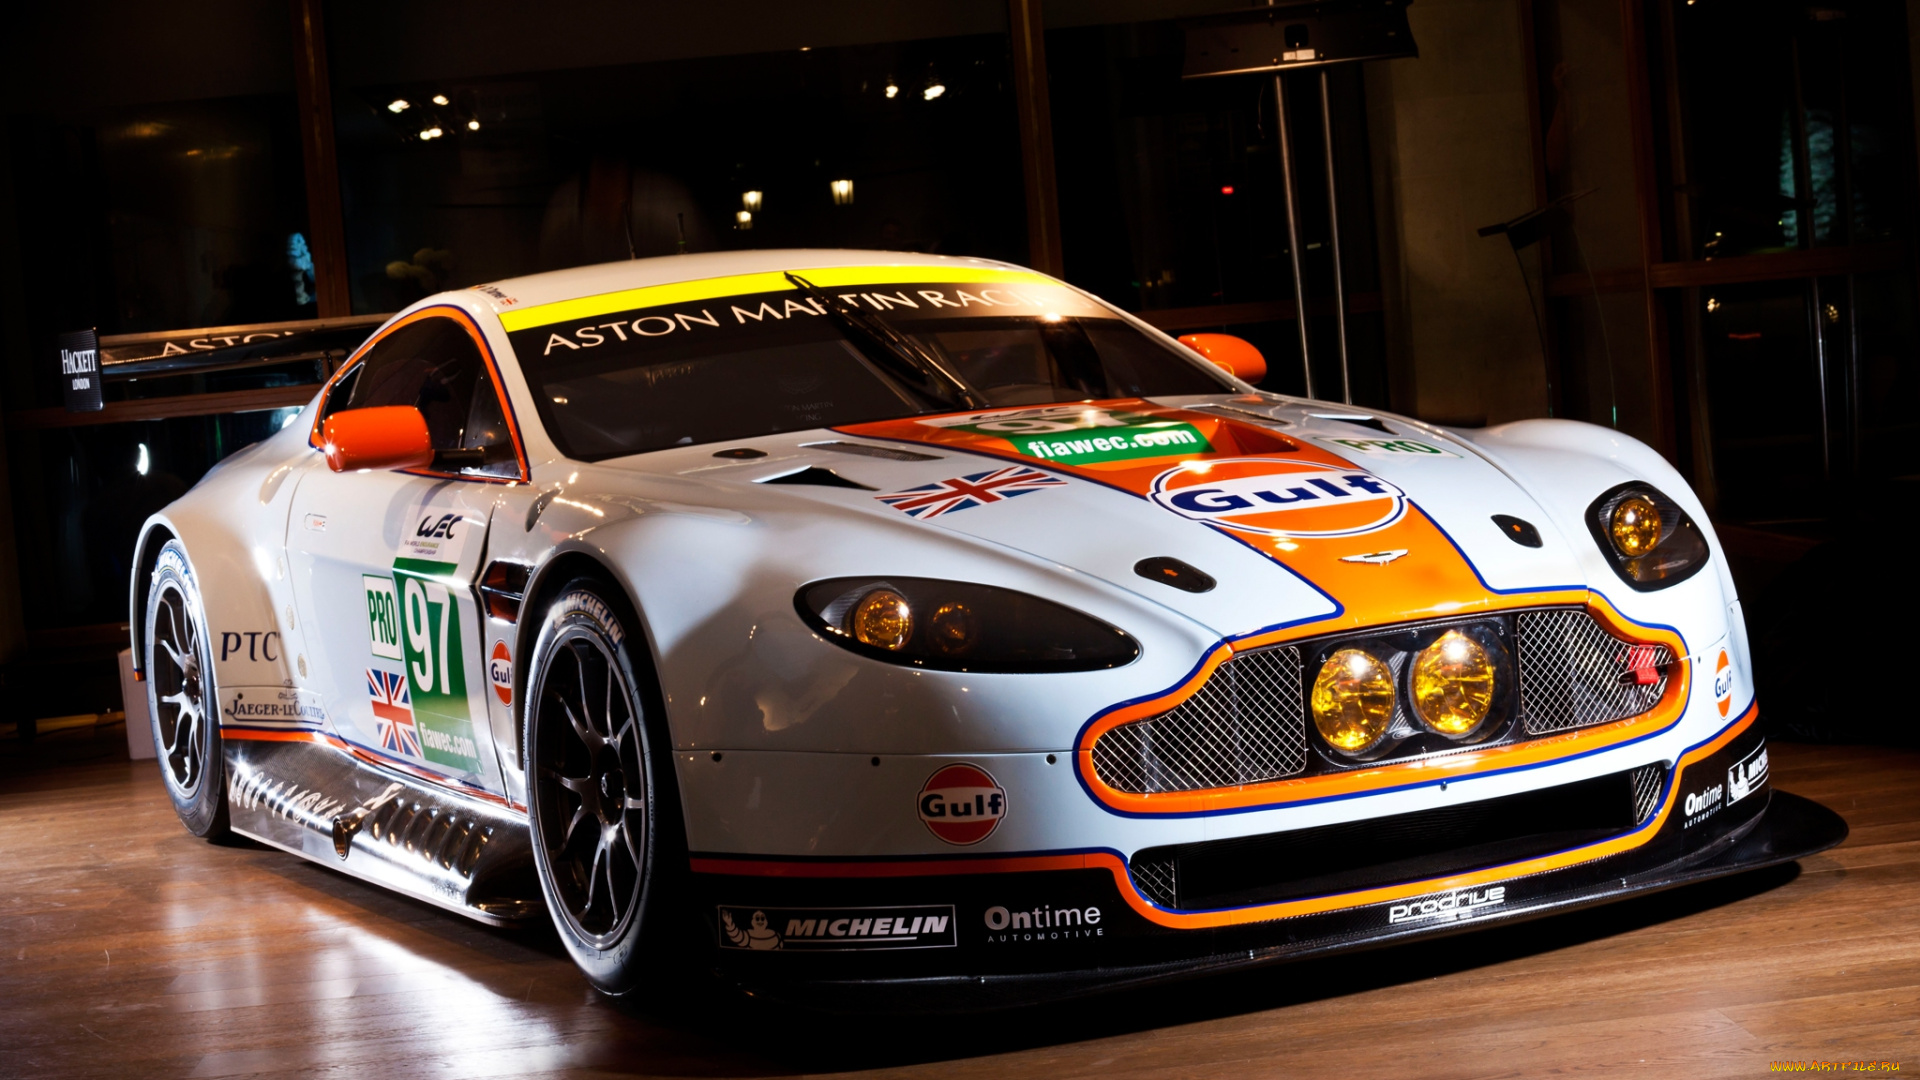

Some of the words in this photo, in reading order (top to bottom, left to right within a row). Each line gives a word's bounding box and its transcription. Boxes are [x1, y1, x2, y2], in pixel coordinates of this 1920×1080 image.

[544, 309, 720, 355] ASTON
[917, 289, 1092, 309] RACI
[163, 331, 294, 357] AST
[61, 349, 96, 374] HACKETT
[72, 378, 90, 391] LONDON
[1027, 429, 1197, 459] fiawec.com
[1332, 439, 1442, 454] PRO
[1170, 474, 1389, 513] Gulf
[416, 513, 464, 540] WEC
[366, 589, 397, 646] PRO
[565, 592, 622, 645] MICHELIN
[221, 631, 280, 662] PTC
[404, 577, 450, 695] 97
[491, 662, 512, 684] Gul
[1715, 669, 1732, 699] Gulf
[420, 722, 477, 758] fiawec.com
[921, 793, 1002, 818] Gulf
[1684, 783, 1723, 817] Ontime
[1684, 802, 1722, 829] AUTOMOTIVE
[785, 915, 949, 937] MICHELIN
[984, 905, 1101, 931] Ontime
[987, 928, 1104, 944] AUTOMOTIVE
